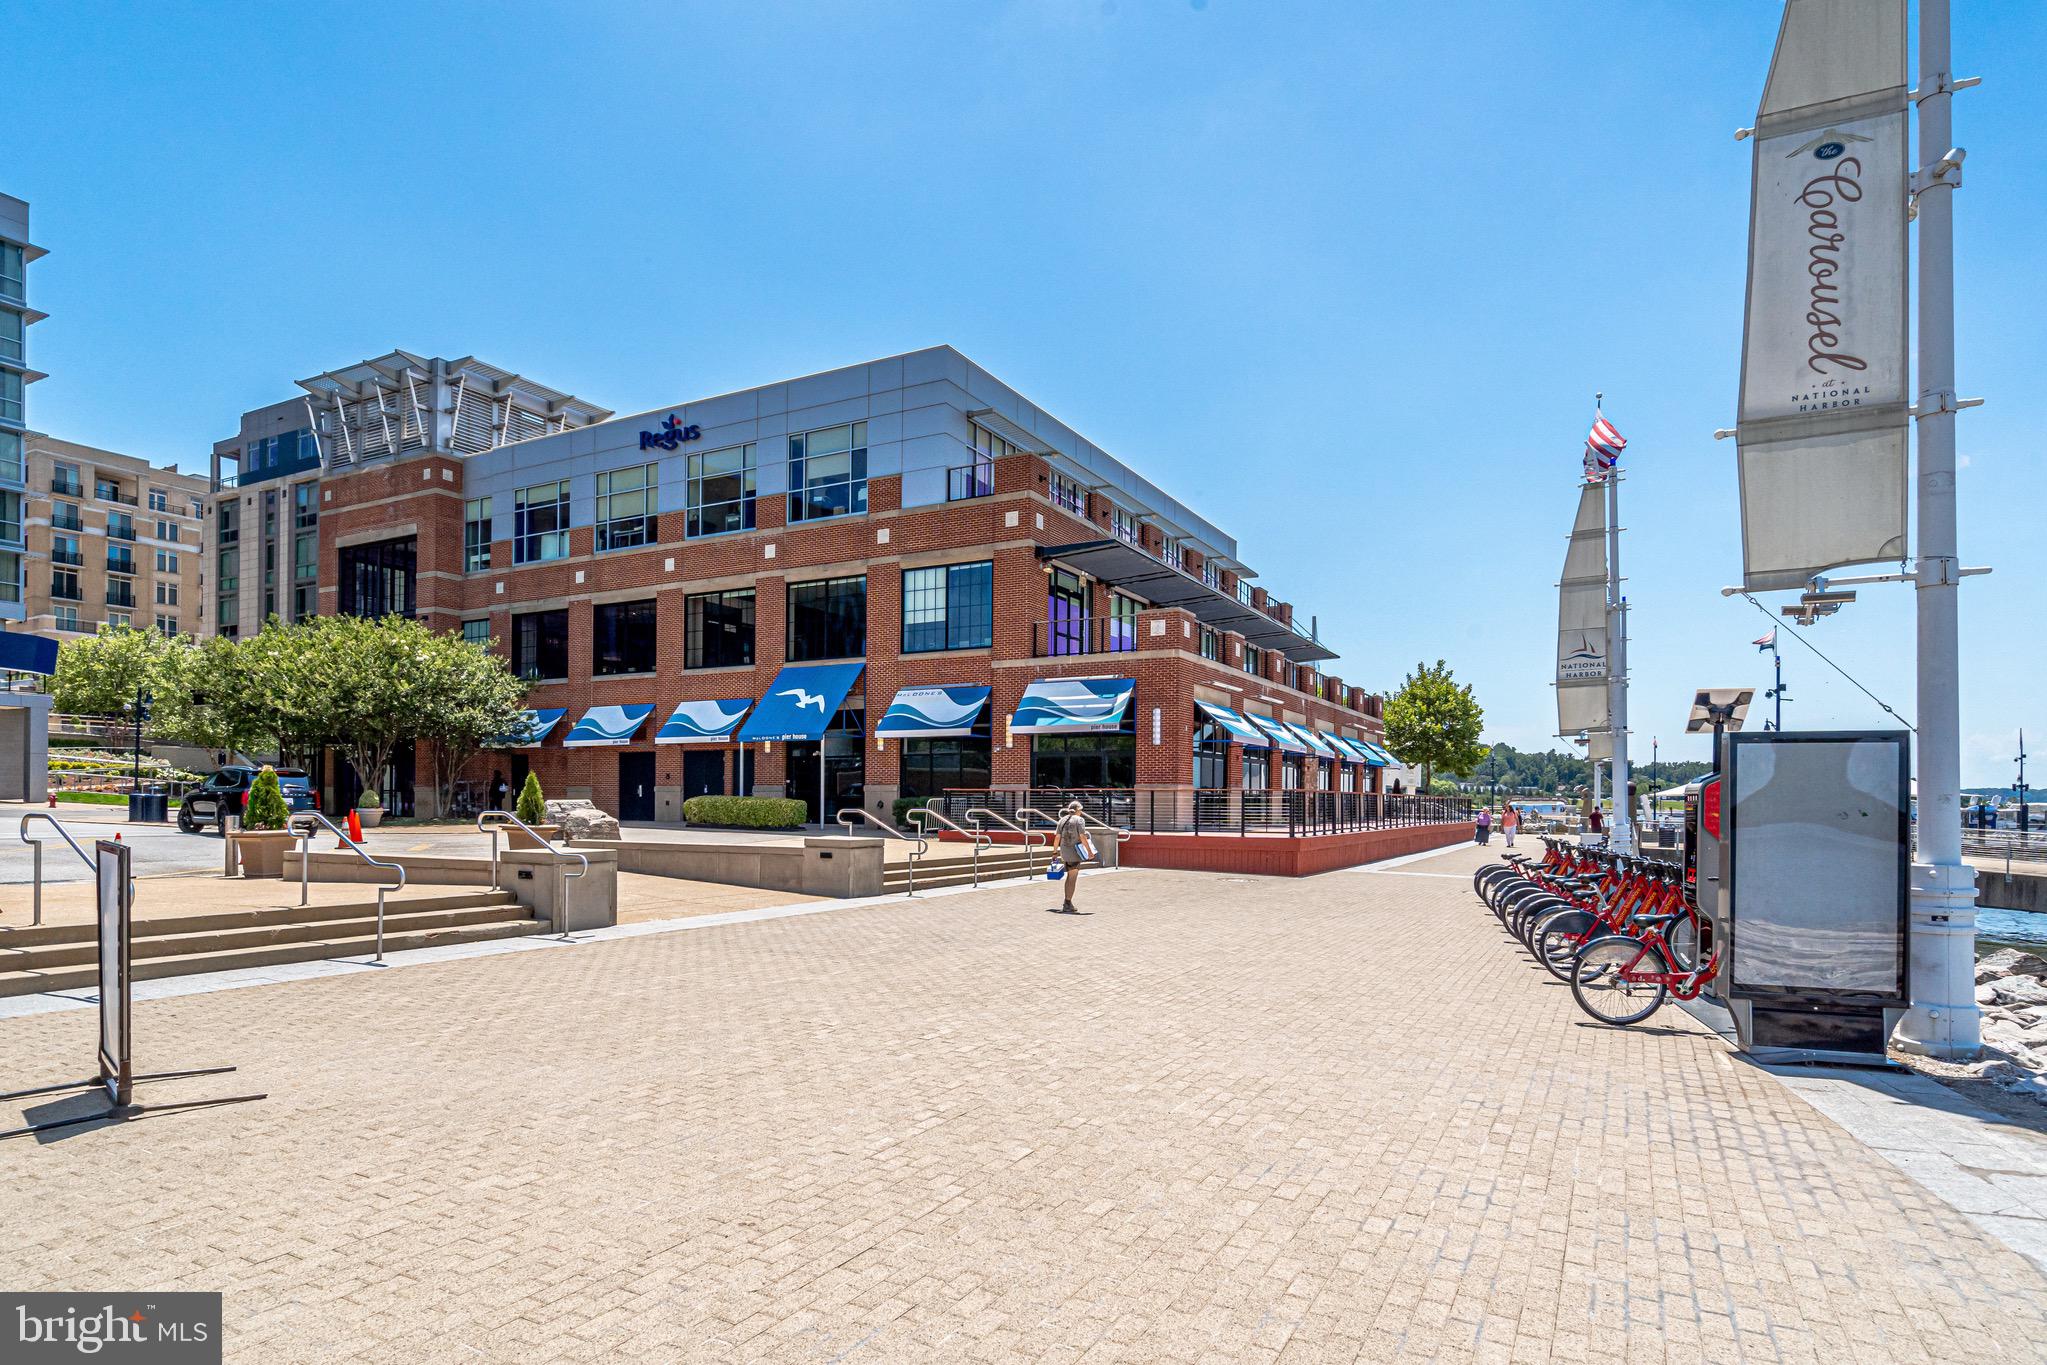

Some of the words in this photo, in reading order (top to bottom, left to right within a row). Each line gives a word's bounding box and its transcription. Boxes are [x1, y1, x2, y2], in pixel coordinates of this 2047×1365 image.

[1820, 145, 1838, 157] the
[1793, 157, 1868, 375] Carousel
[1822, 379, 1837, 388] at
[1791, 386, 1870, 402] NATIONAL
[1799, 398, 1861, 412] HARBOR
[639, 425, 701, 450] Regus
[781, 732, 792, 741] pier
